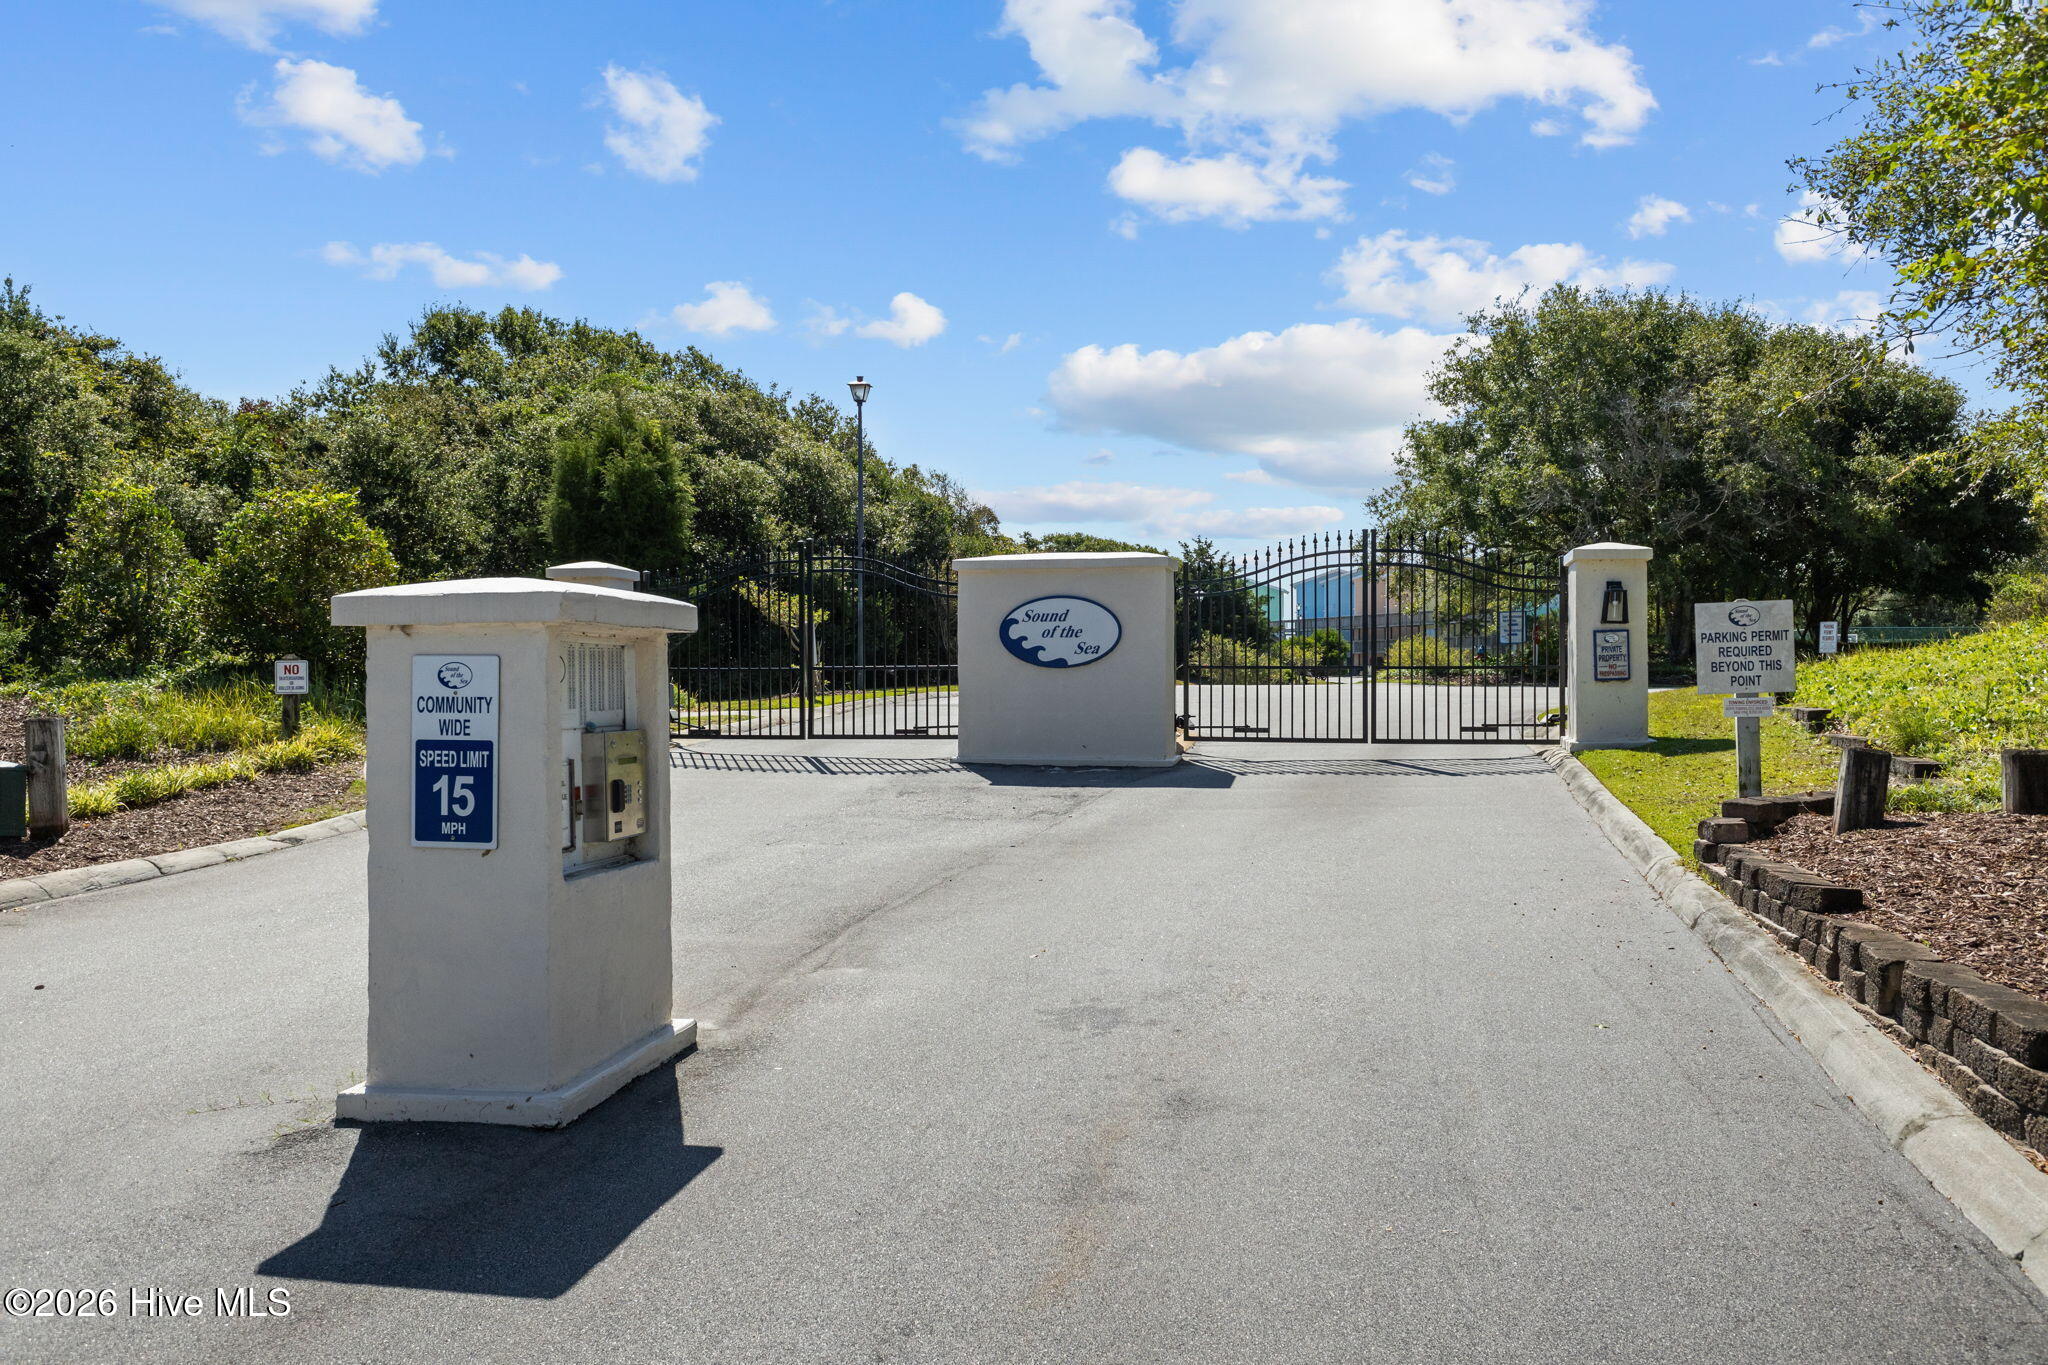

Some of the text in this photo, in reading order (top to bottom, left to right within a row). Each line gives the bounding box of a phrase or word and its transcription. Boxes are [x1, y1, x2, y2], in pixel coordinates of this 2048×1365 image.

[1021, 609, 1070, 622] Sound
[1041, 625, 1083, 638] of the
[1701, 629, 1790, 643] PARKING PERMIT
[1074, 641, 1101, 655] Sea
[1601, 645, 1623, 653] PRIVATE
[1718, 645, 1772, 658] REQUIRED
[1598, 654, 1627, 662] PROPERTY
[283, 664, 300, 675] NO
[1711, 659, 1782, 673] BEYOND THIS
[1730, 675, 1762, 687] POINT
[416, 696, 493, 714] COMMUNITY
[438, 719, 471, 736] WIDE
[419, 750, 490, 768] SPEED LIMIT
[432, 774, 476, 817] 15
[441, 822, 466, 835] MPH
